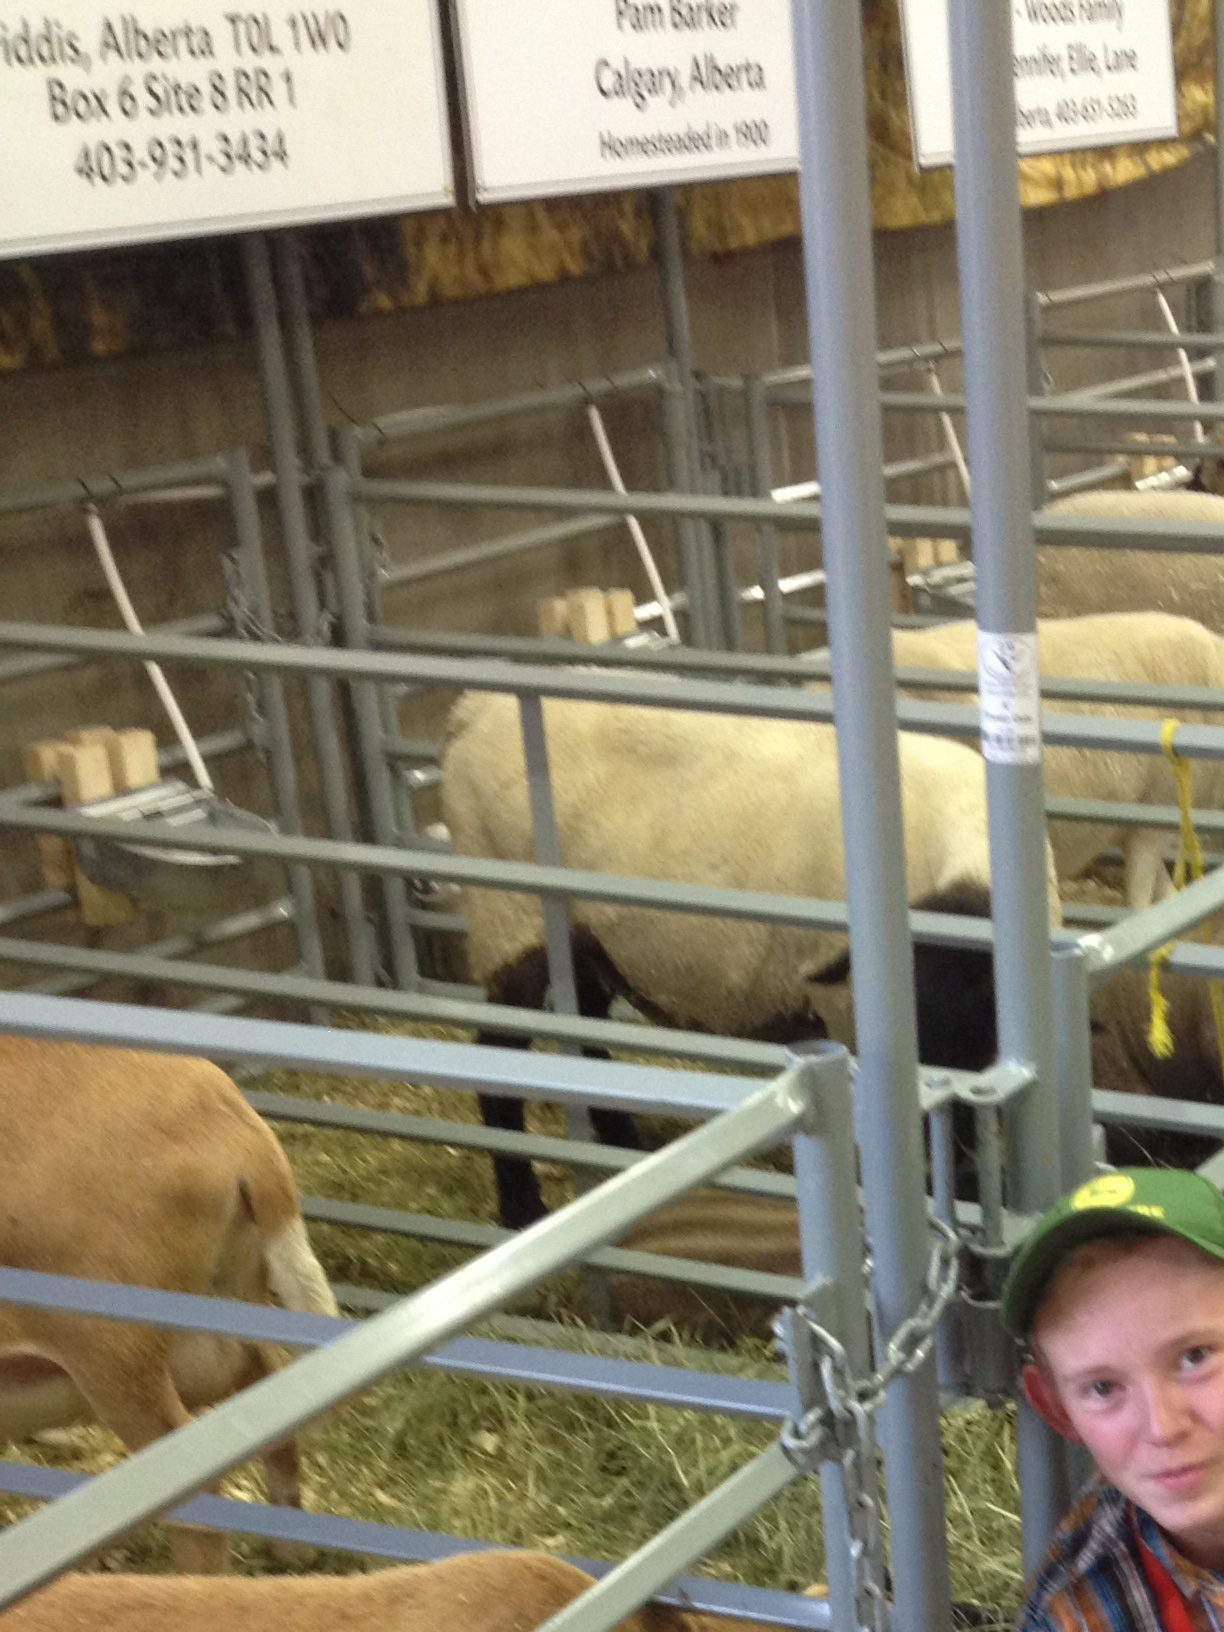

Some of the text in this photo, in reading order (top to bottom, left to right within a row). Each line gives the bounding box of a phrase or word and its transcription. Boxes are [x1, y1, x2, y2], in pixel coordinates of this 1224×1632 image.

[0, 17, 91, 73] iddis,
[102, 14, 216, 64] Alberta
[1013, 44, 1066, 82] ennifer,
[48, 67, 298, 124] Box 6 Site 8 RR 1
[594, 52, 765, 112] Calgary, Alberta
[75, 128, 289, 187] 403-931-3434
